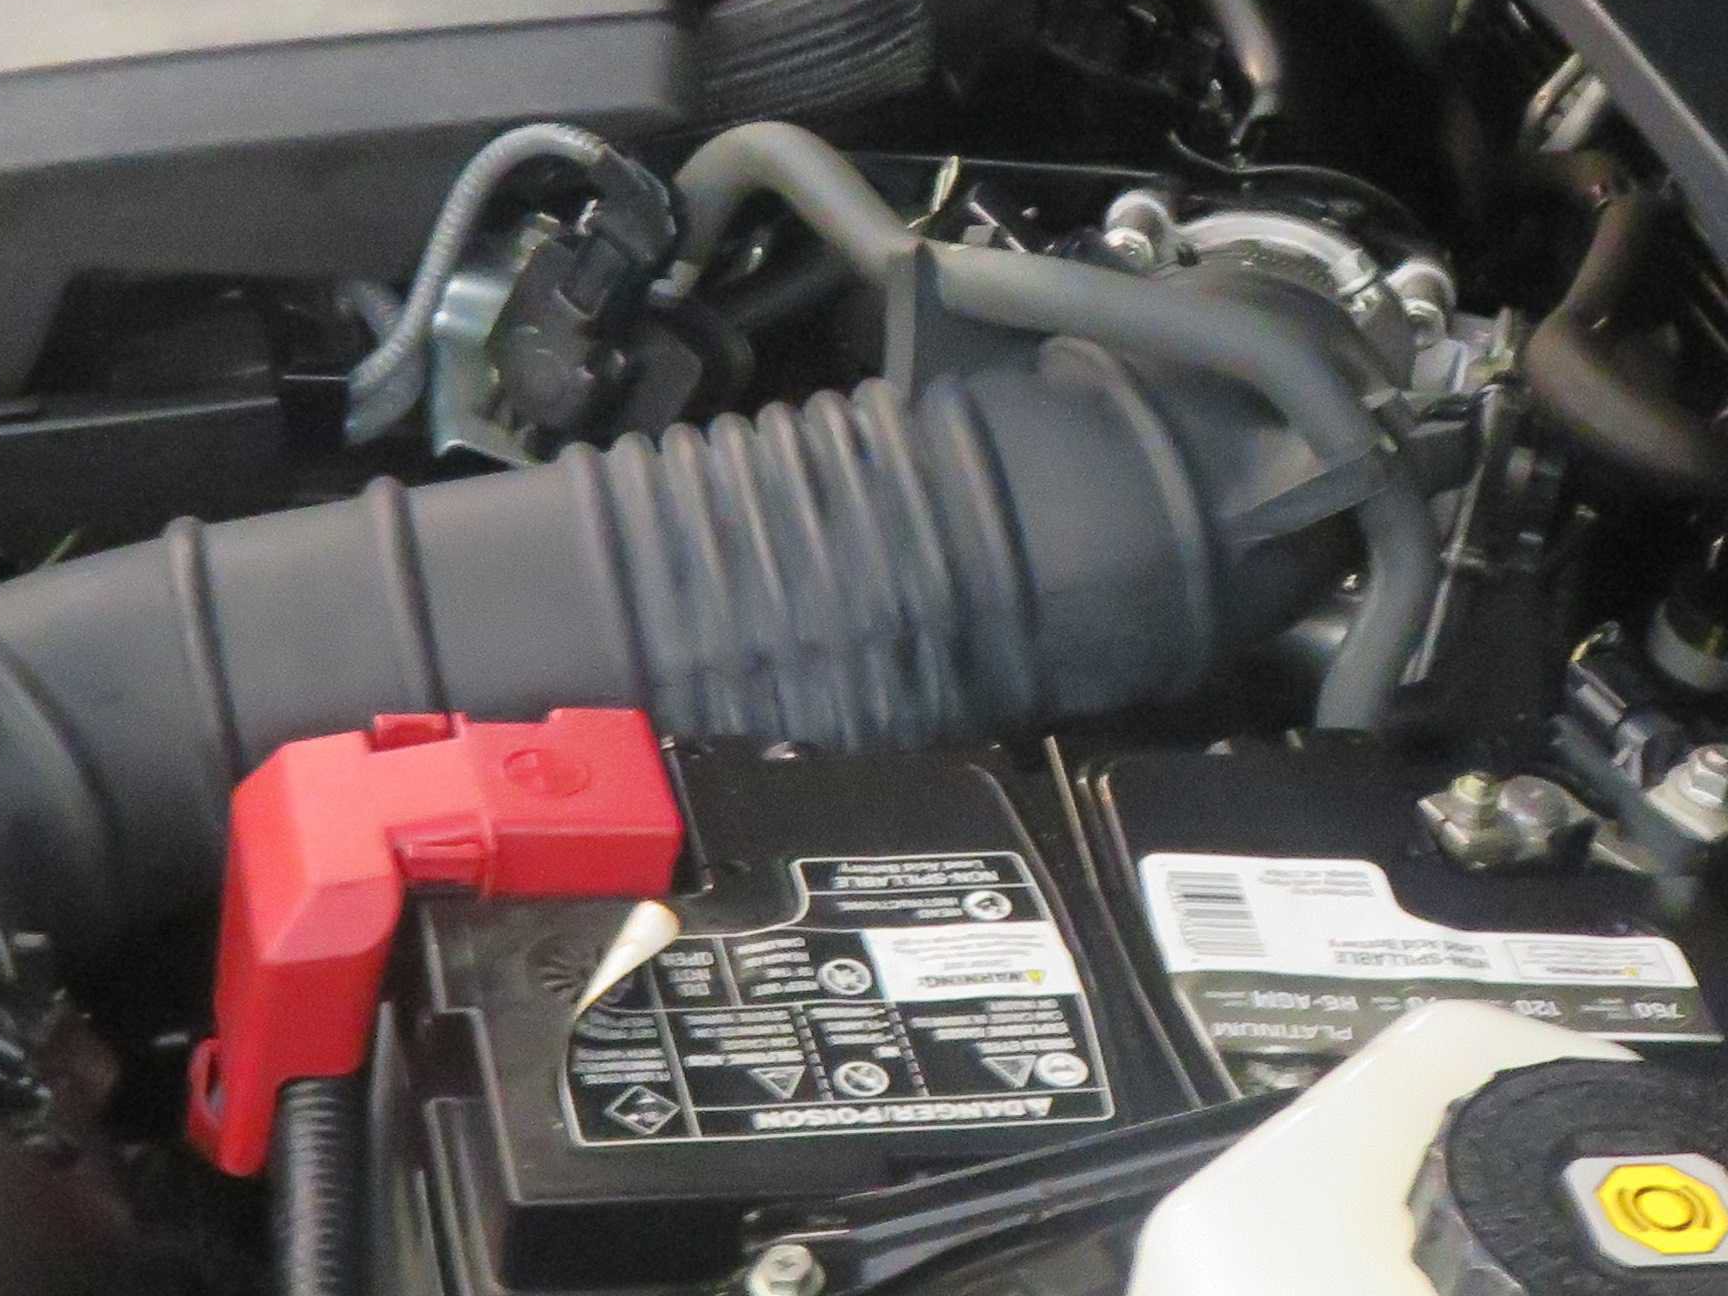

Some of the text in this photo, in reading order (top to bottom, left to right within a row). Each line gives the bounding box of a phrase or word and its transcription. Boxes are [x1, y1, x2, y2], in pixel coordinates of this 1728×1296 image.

[834, 870, 998, 888] NON-SPILLABLE
[1212, 1022, 1353, 1040] PLATINUM
[754, 1099, 1026, 1130] DANGER/POISON
